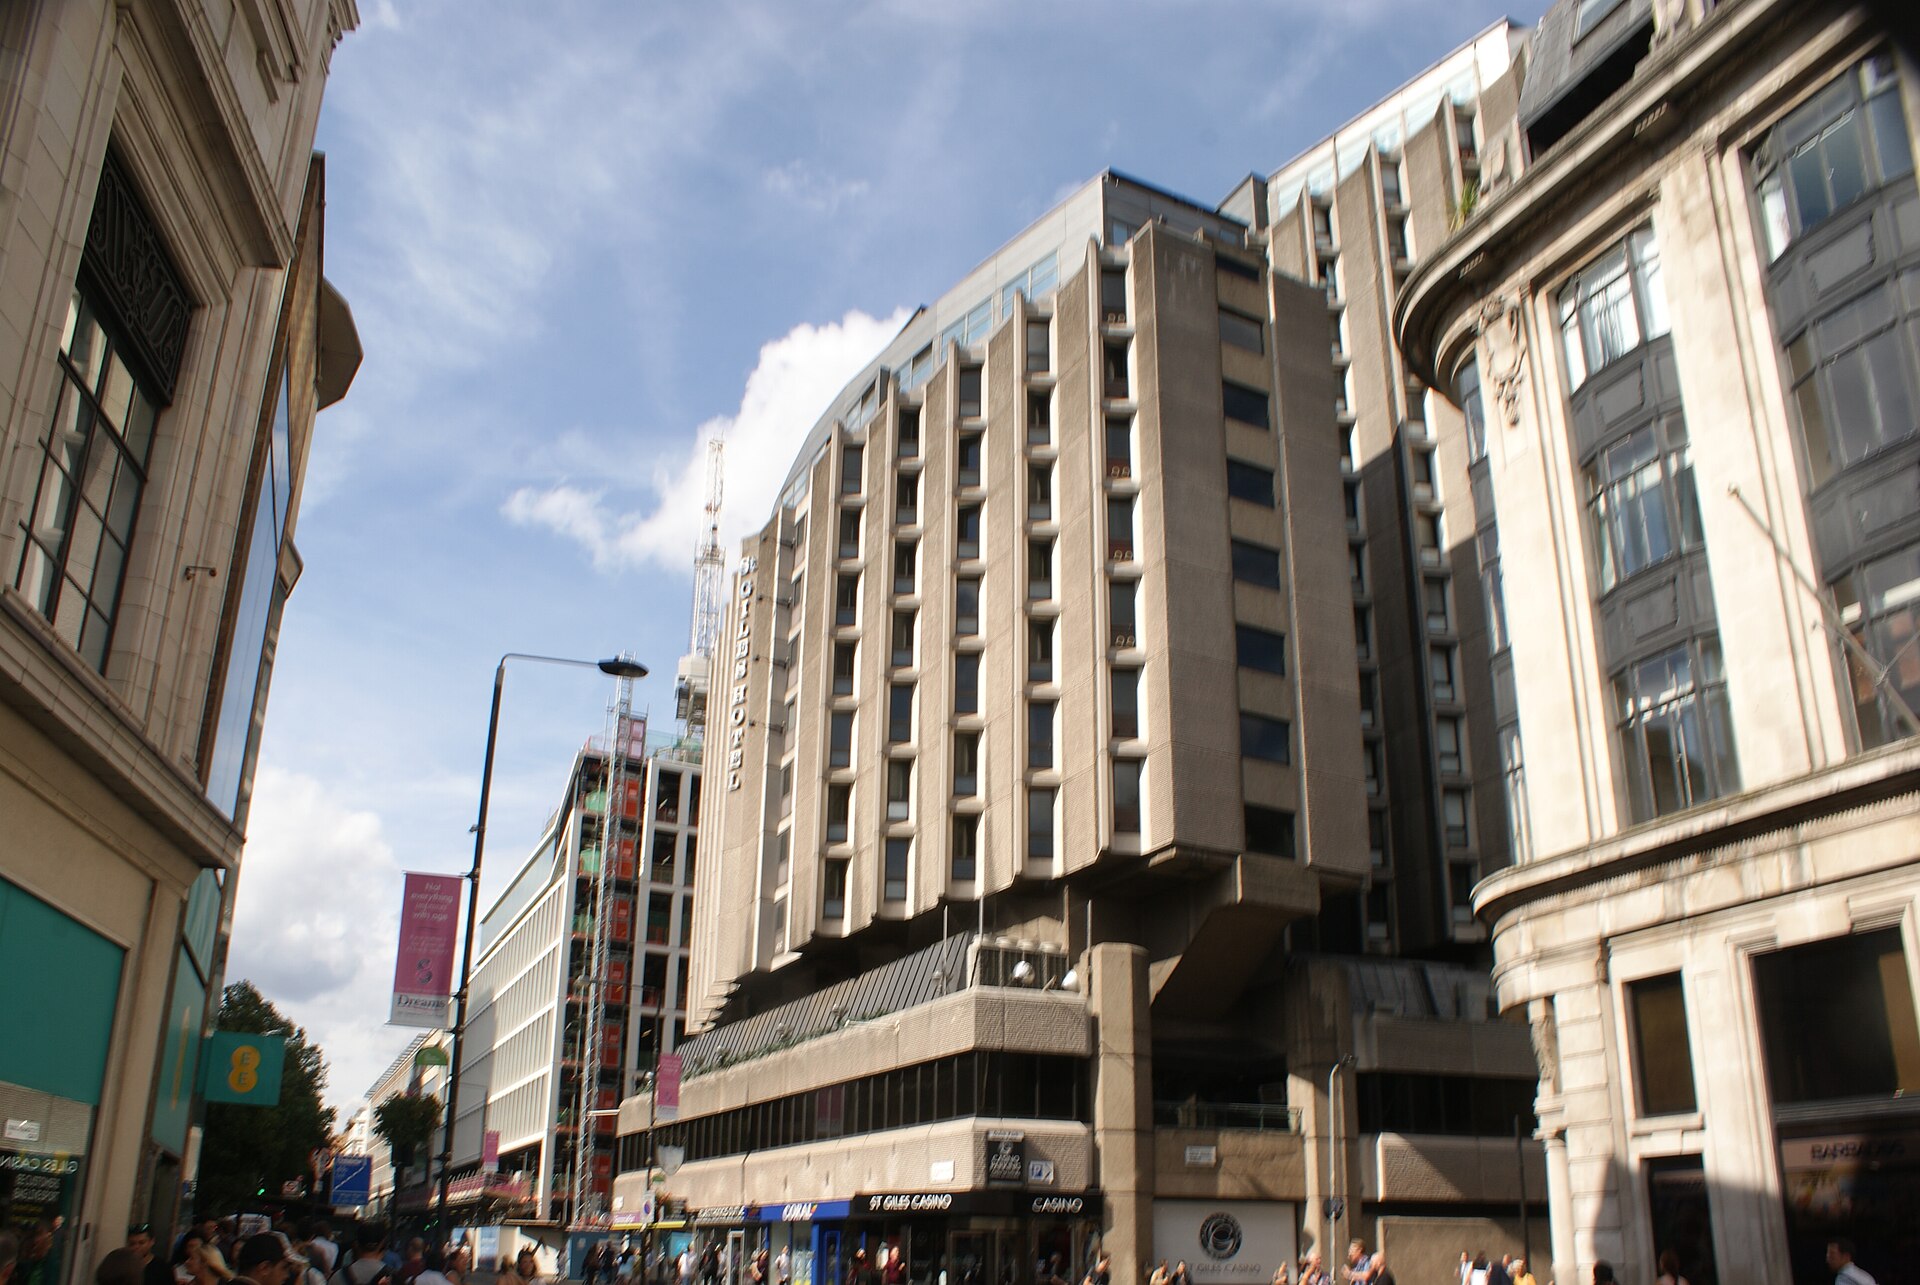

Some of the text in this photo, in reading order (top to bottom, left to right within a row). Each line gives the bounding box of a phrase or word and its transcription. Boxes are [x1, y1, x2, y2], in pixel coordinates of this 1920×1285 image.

[735, 579, 753, 681] GILES
[728, 684, 747, 792] HOTEL
[397, 994, 446, 1009] Dreams
[869, 1194, 952, 1211] ST GILES CASINO
[1032, 1197, 1083, 1213] CASINO
[782, 1203, 813, 1222] CORAL
[1224, 1263, 1261, 1273] CASINO
